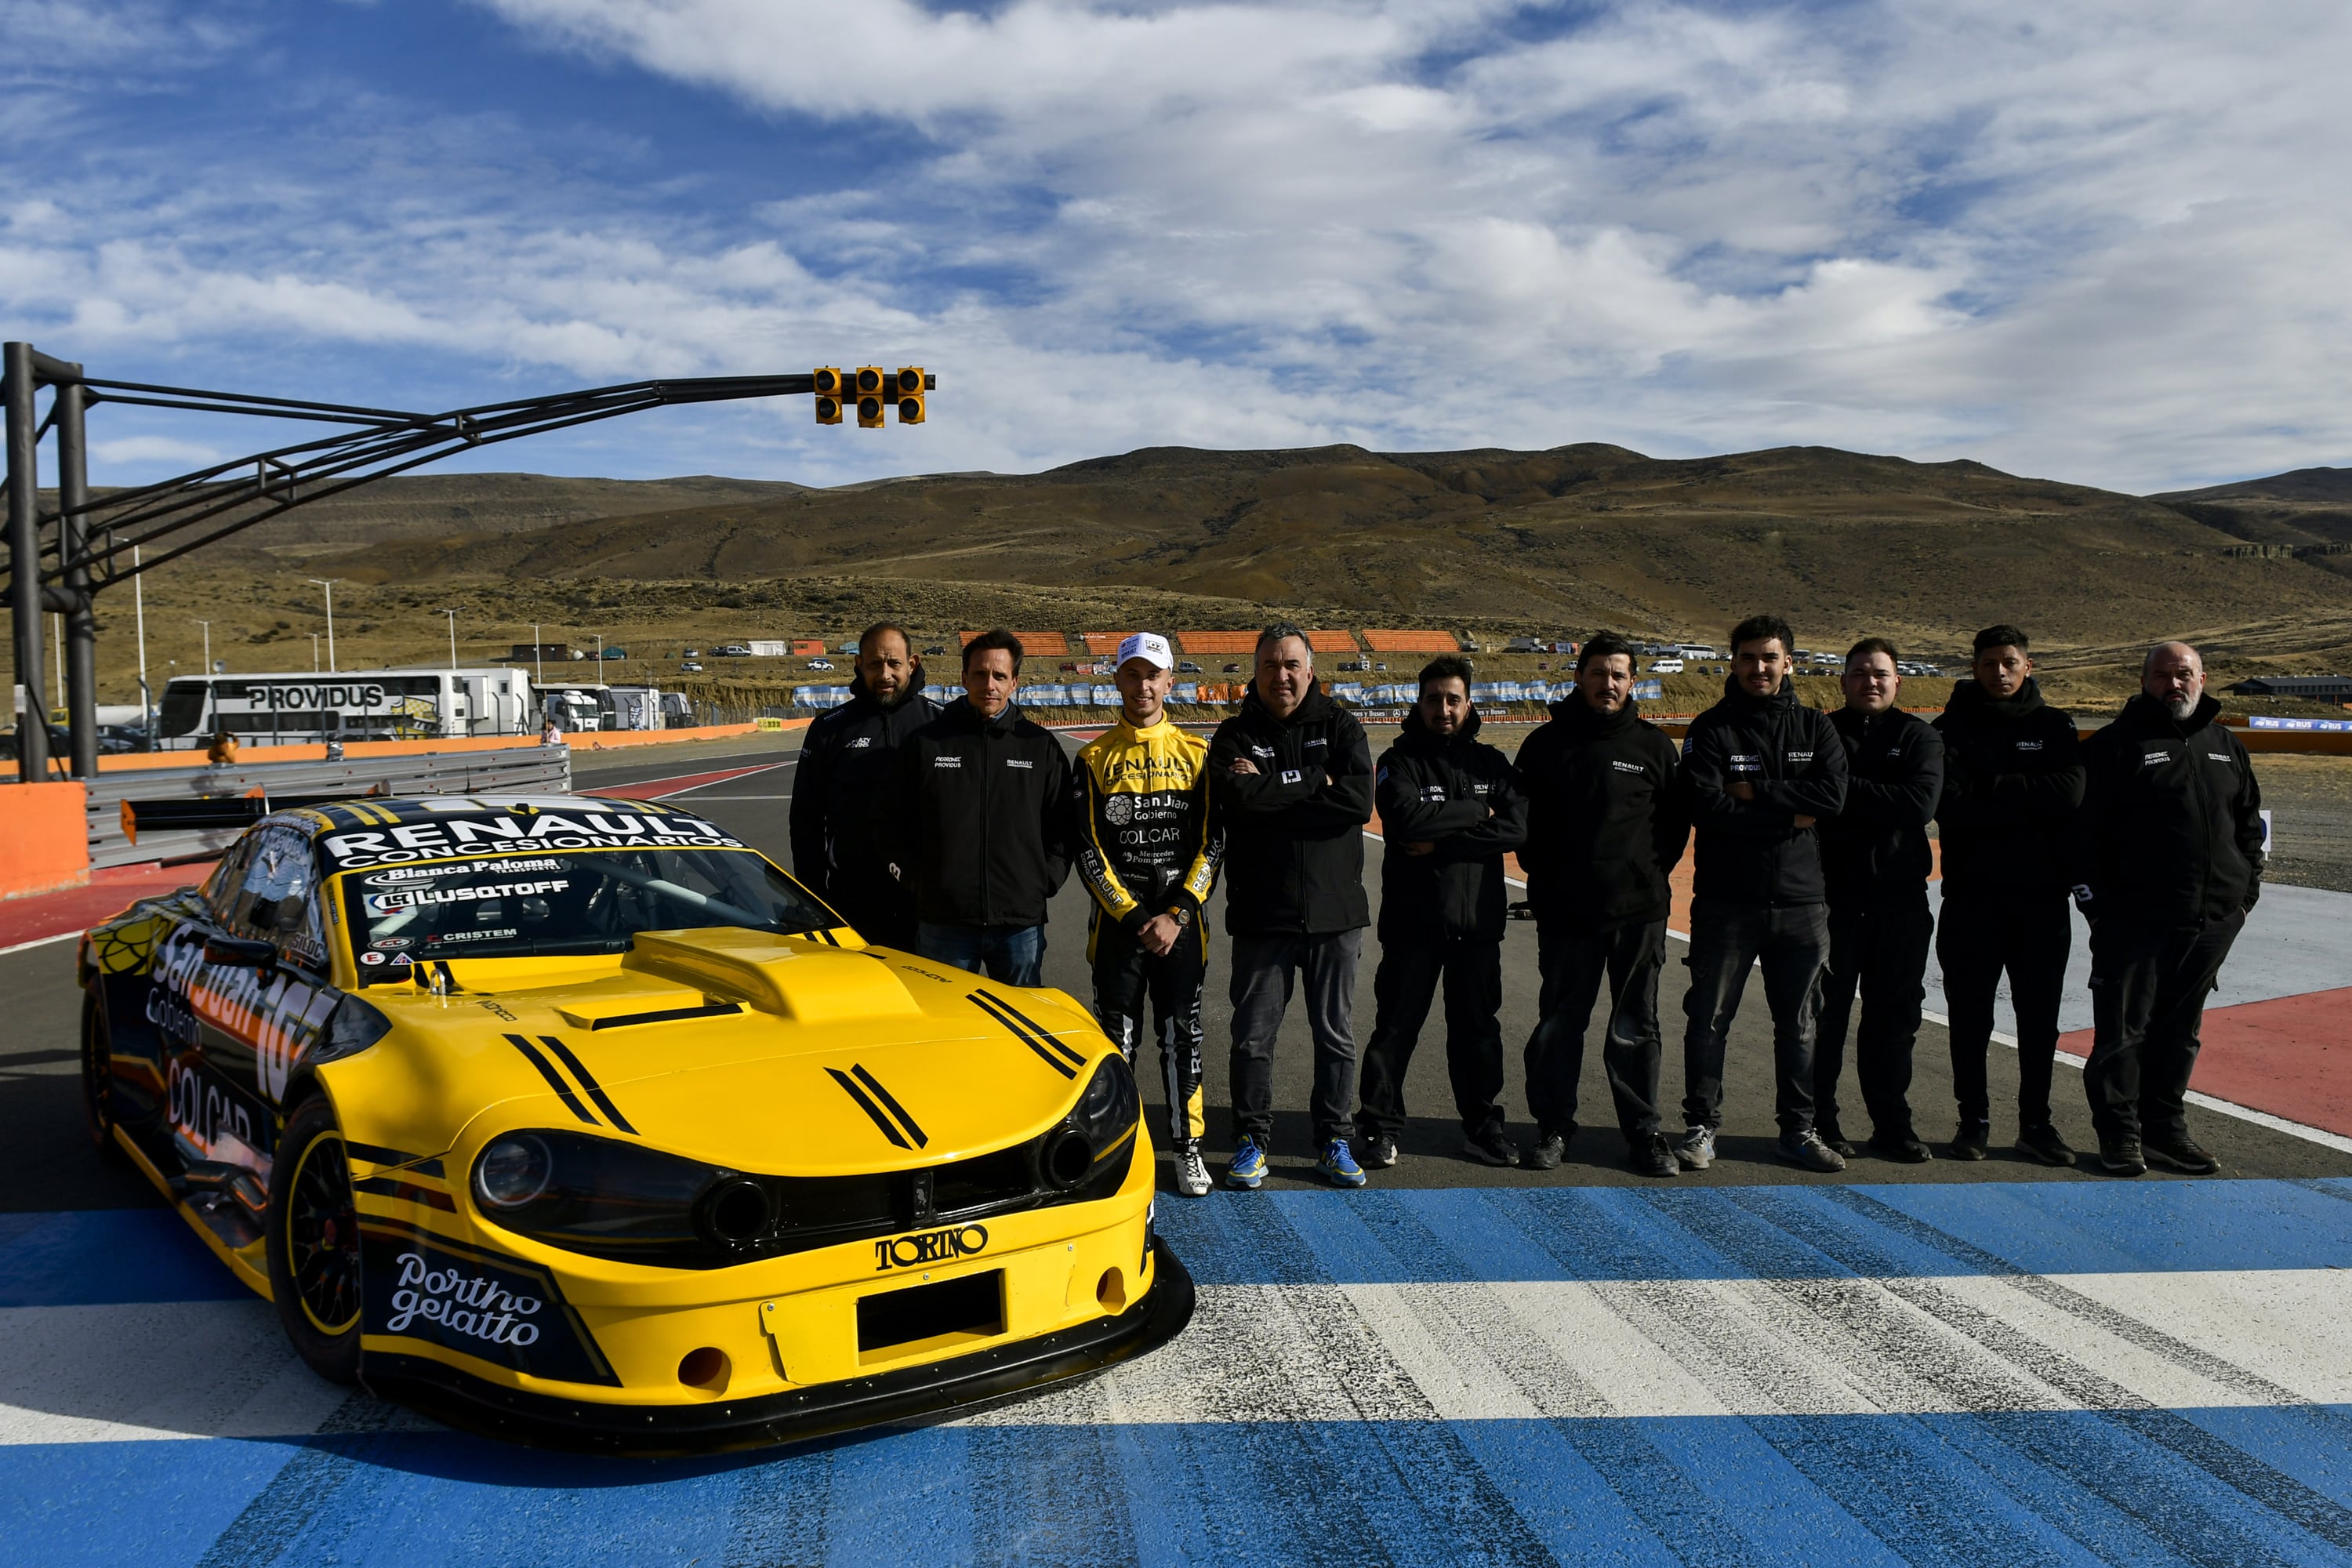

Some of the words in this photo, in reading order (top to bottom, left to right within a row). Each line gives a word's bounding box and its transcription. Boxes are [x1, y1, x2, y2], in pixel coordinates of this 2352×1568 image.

[249, 685, 383, 710] PROVIDUS
[1613, 760, 1645, 772] RENAULT
[1105, 771, 1192, 786] ONCESIONARIOS
[1134, 796, 1160, 808] San
[1134, 810, 1177, 820] Gobierno
[324, 814, 721, 858] RENAULT
[1120, 828, 1180, 844] COLCAR
[339, 836, 743, 868] CONCESIONARIOS
[389, 866, 470, 880] Blanca
[471, 858, 557, 873] Paloma
[495, 865, 561, 874] TRANSPORTES
[416, 880, 569, 903] LUSQTOFF
[443, 928, 517, 941] CRISTEM
[153, 923, 205, 1000] San
[875, 1224, 989, 1271] TORINO
[396, 1253, 543, 1315] Portho
[387, 1289, 539, 1345] gelatto
